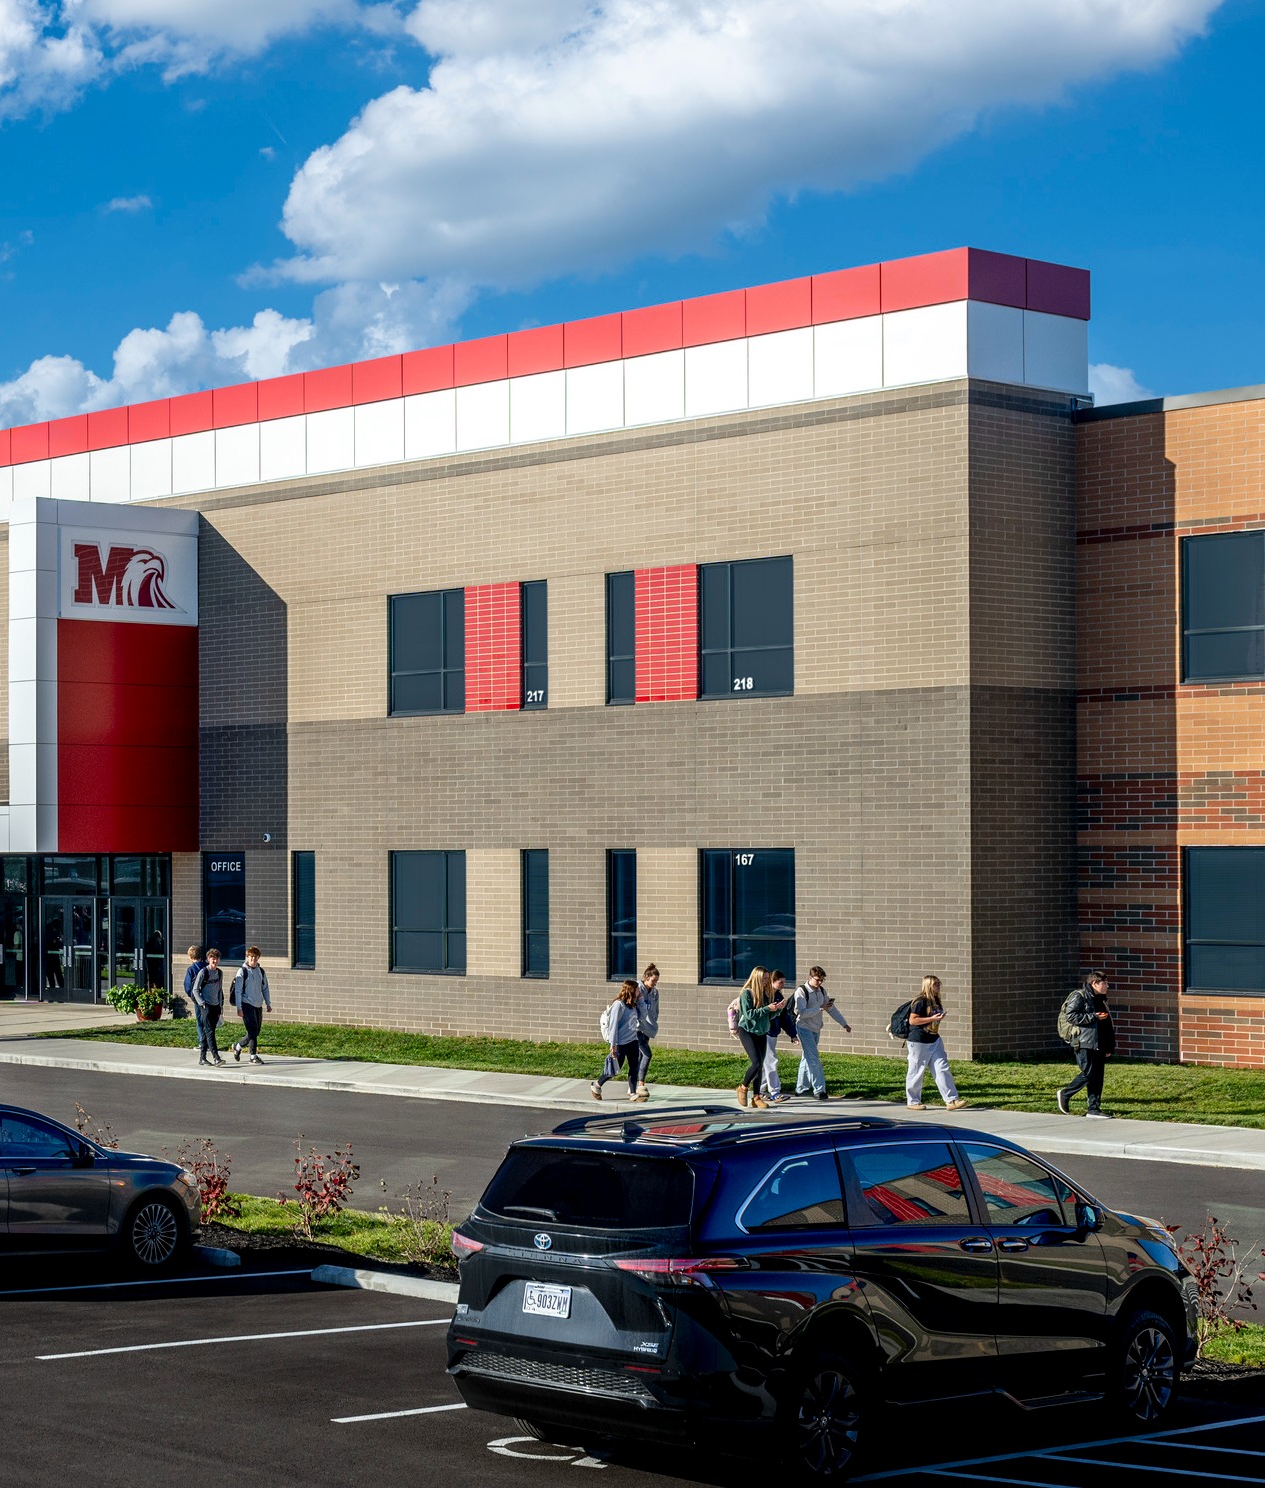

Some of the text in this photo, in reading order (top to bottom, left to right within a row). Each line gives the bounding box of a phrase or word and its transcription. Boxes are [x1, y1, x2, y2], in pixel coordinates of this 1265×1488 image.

[733, 677, 754, 691] 218
[527, 690, 544, 702] 217
[735, 854, 754, 866] 167
[211, 861, 242, 872] OFFICE
